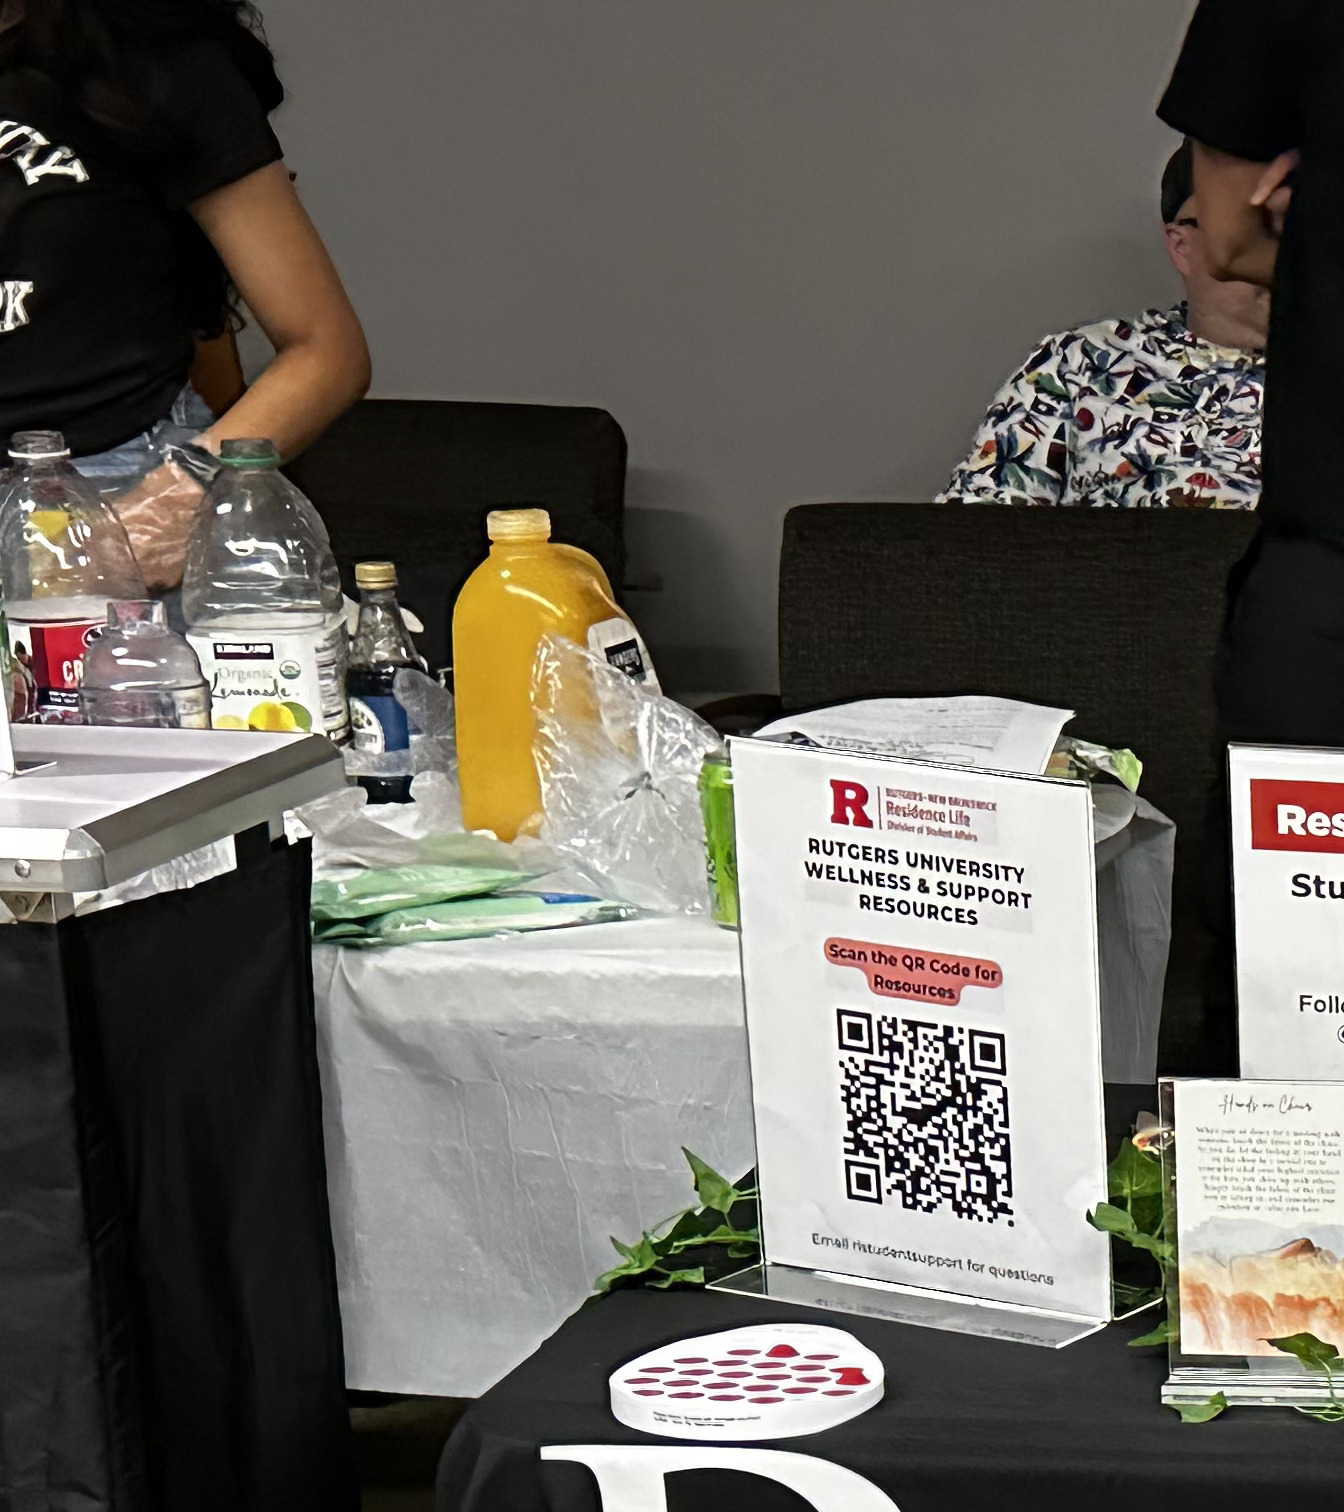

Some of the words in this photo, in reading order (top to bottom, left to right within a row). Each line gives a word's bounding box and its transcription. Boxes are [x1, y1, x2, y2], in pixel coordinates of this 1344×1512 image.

[830, 779, 873, 828] R
[886, 801, 945, 823] Residence
[949, 810, 971, 827] Life
[808, 838, 899, 865] RUTGERS
[906, 851, 1024, 884] UNIVERSITY
[805, 861, 910, 891] WELLNESS
[918, 878, 929, 894] &
[937, 881, 1032, 909] SUPPORT
[860, 894, 978, 925] RESOURCES
[829, 944, 867, 963] Scan
[872, 951, 897, 966] the
[902, 955, 924, 972] QR
[930, 960, 970, 977] Code
[975, 965, 998, 981] for
[874, 974, 955, 999] Resources
[812, 1233, 848, 1249] Email
[967, 1259, 985, 1273] for
[989, 1265, 1054, 1285] questions
